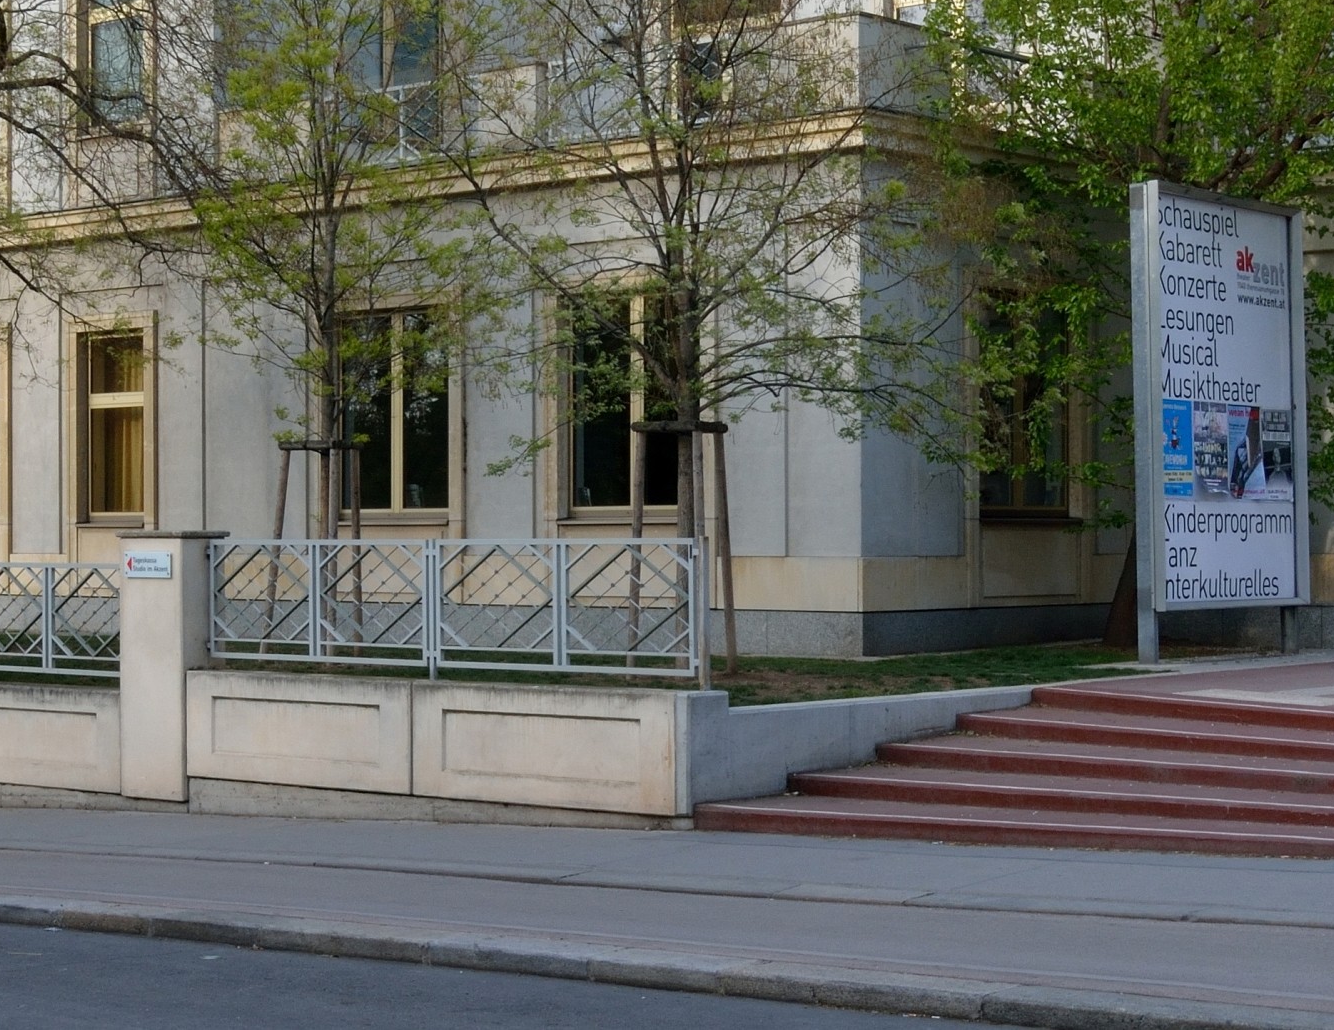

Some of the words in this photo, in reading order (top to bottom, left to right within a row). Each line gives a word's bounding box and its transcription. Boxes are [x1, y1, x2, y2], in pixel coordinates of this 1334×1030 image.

[1236, 246, 1285, 287] akzent
[1237, 295, 1286, 310] www.akzent.at
[1161, 309, 1234, 342] esungen
[1165, 538, 1198, 567] anz
[1165, 569, 1280, 601] nterkulturelles
